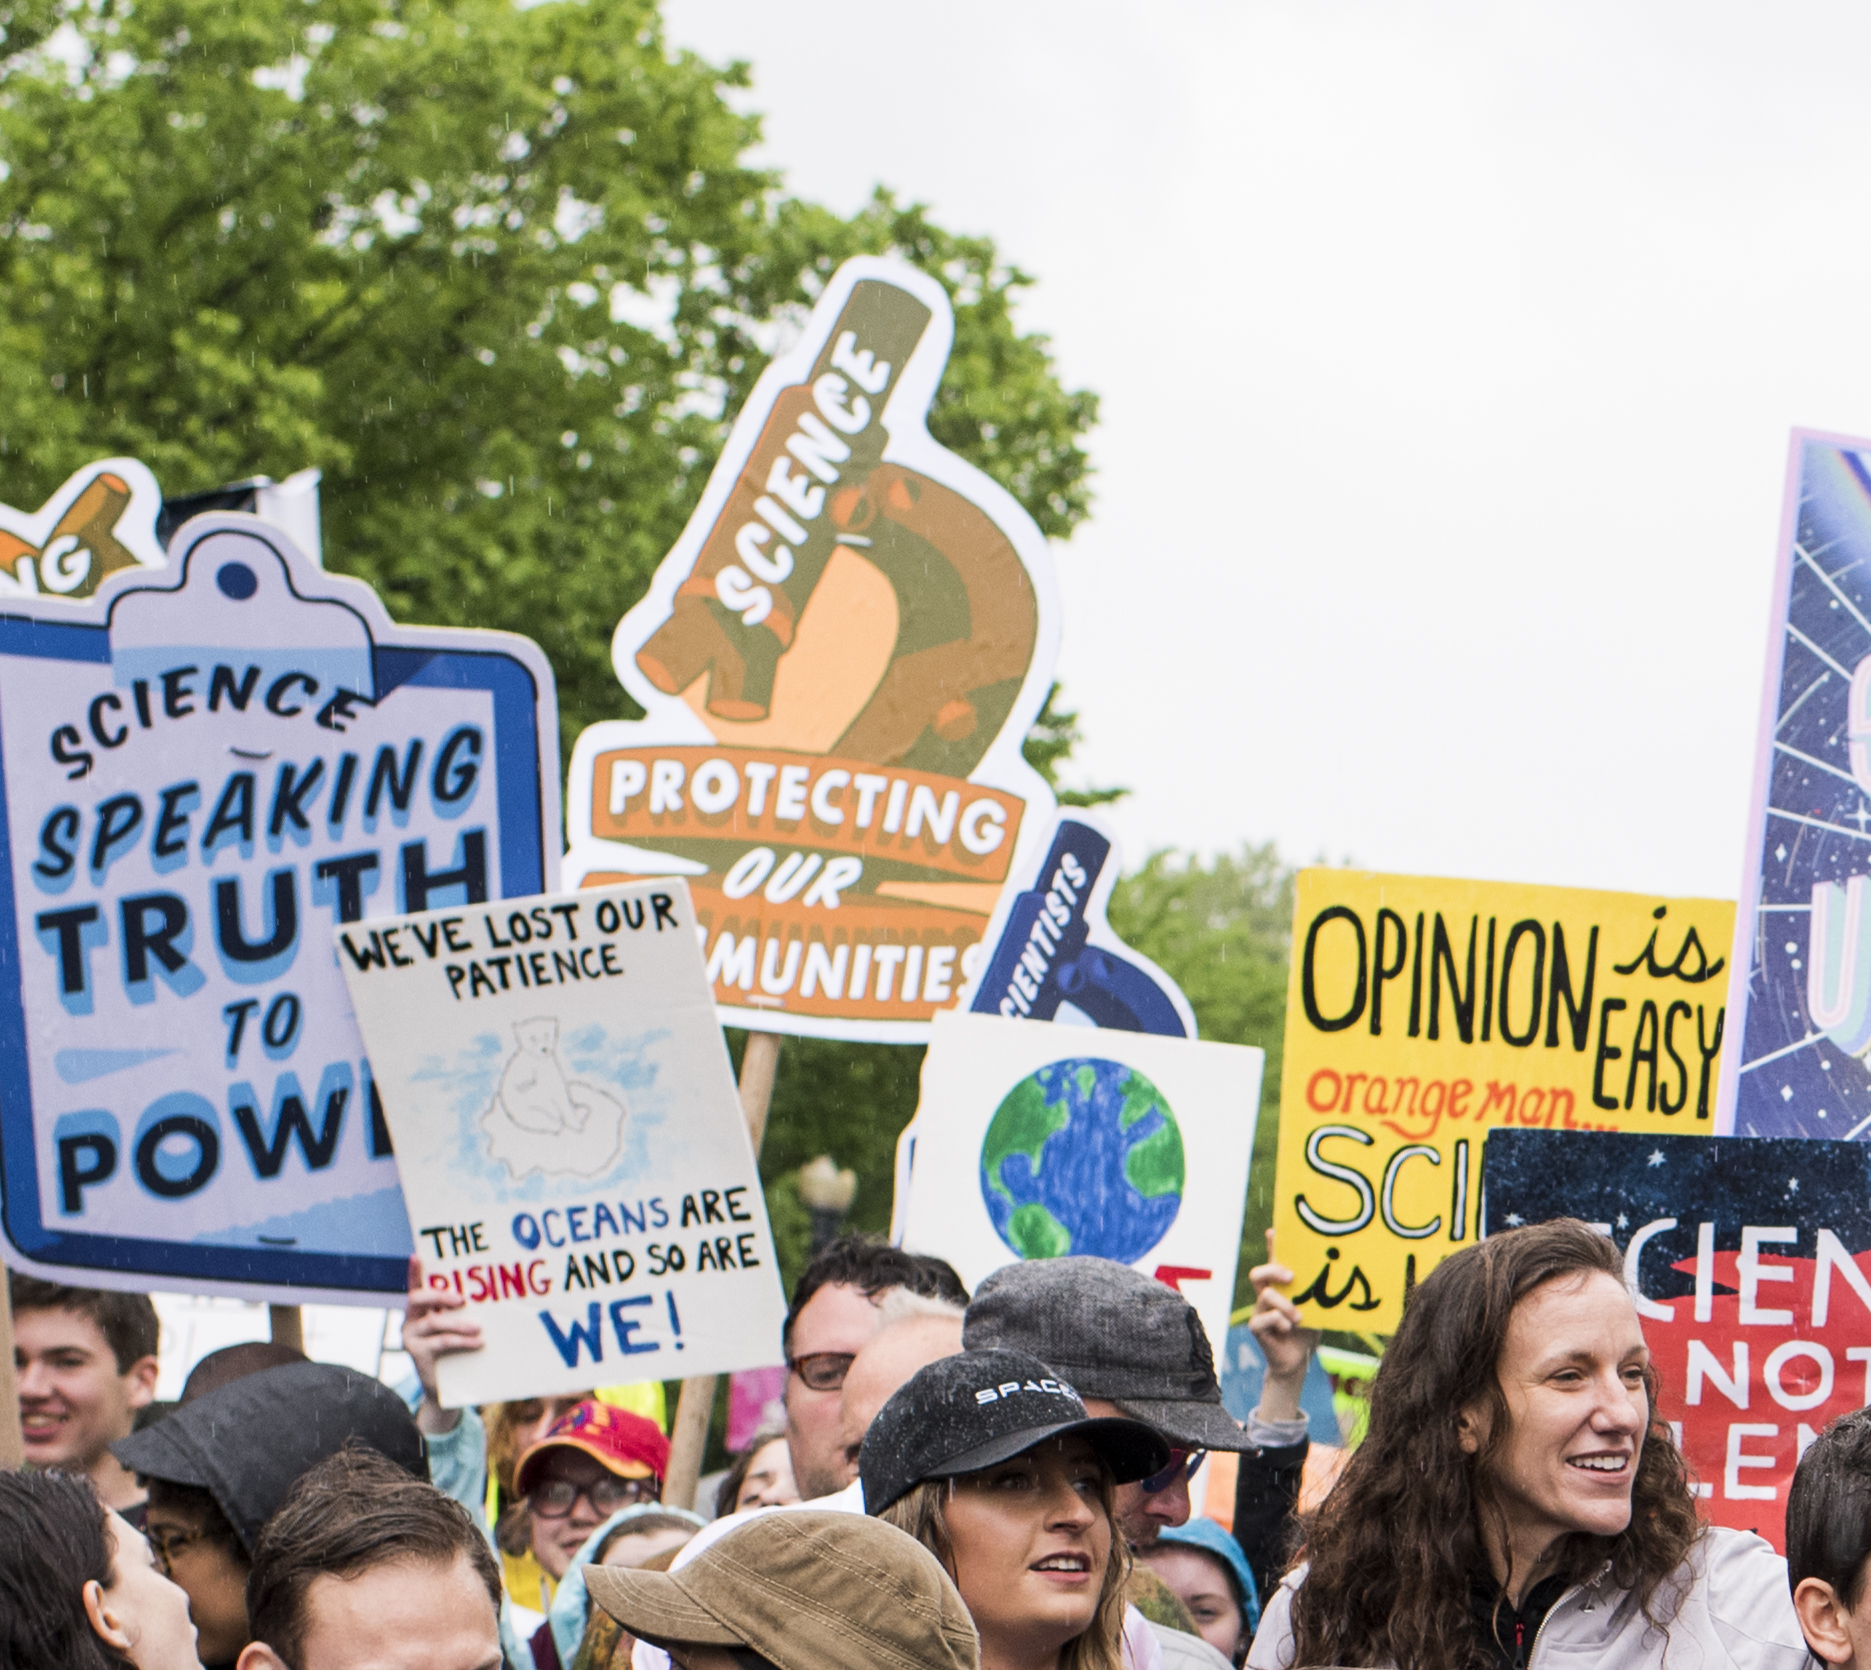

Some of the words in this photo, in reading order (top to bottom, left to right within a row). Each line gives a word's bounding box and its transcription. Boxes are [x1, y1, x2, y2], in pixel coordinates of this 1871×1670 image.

[714, 330, 891, 626] SCIENCE
[50, 664, 374, 781] SCIENCE
[34, 724, 485, 880] SPEAKING
[609, 758, 1006, 855] PROTECTING
[37, 829, 489, 996] TRUTH
[722, 846, 863, 909] OUR
[341, 917, 472, 972] WE'VE
[485, 904, 582, 949] LOST
[596, 893, 680, 934] OUR
[445, 944, 624, 1000] PATIENCE
[697, 924, 982, 1003] MUNITIES
[1000, 852, 1088, 1019] CIENTISTS
[1302, 905, 1599, 1052] OPINION
[1613, 905, 1725, 983] is
[225, 995, 301, 1056] TO
[1592, 997, 1725, 1120] EASY
[1306, 1067, 1475, 1140] orange
[58, 1086, 396, 1213] POW
[1295, 1125, 1488, 1242] SCI
[421, 1222, 490, 1260] THE
[512, 1197, 669, 1250] OCEANS
[680, 1186, 752, 1230] ARE
[564, 1250, 636, 1292] AND
[648, 1244, 686, 1275] SO
[696, 1234, 761, 1271] ARE
[1292, 1247, 1381, 1311] is
[538, 1290, 686, 1369] WE!
